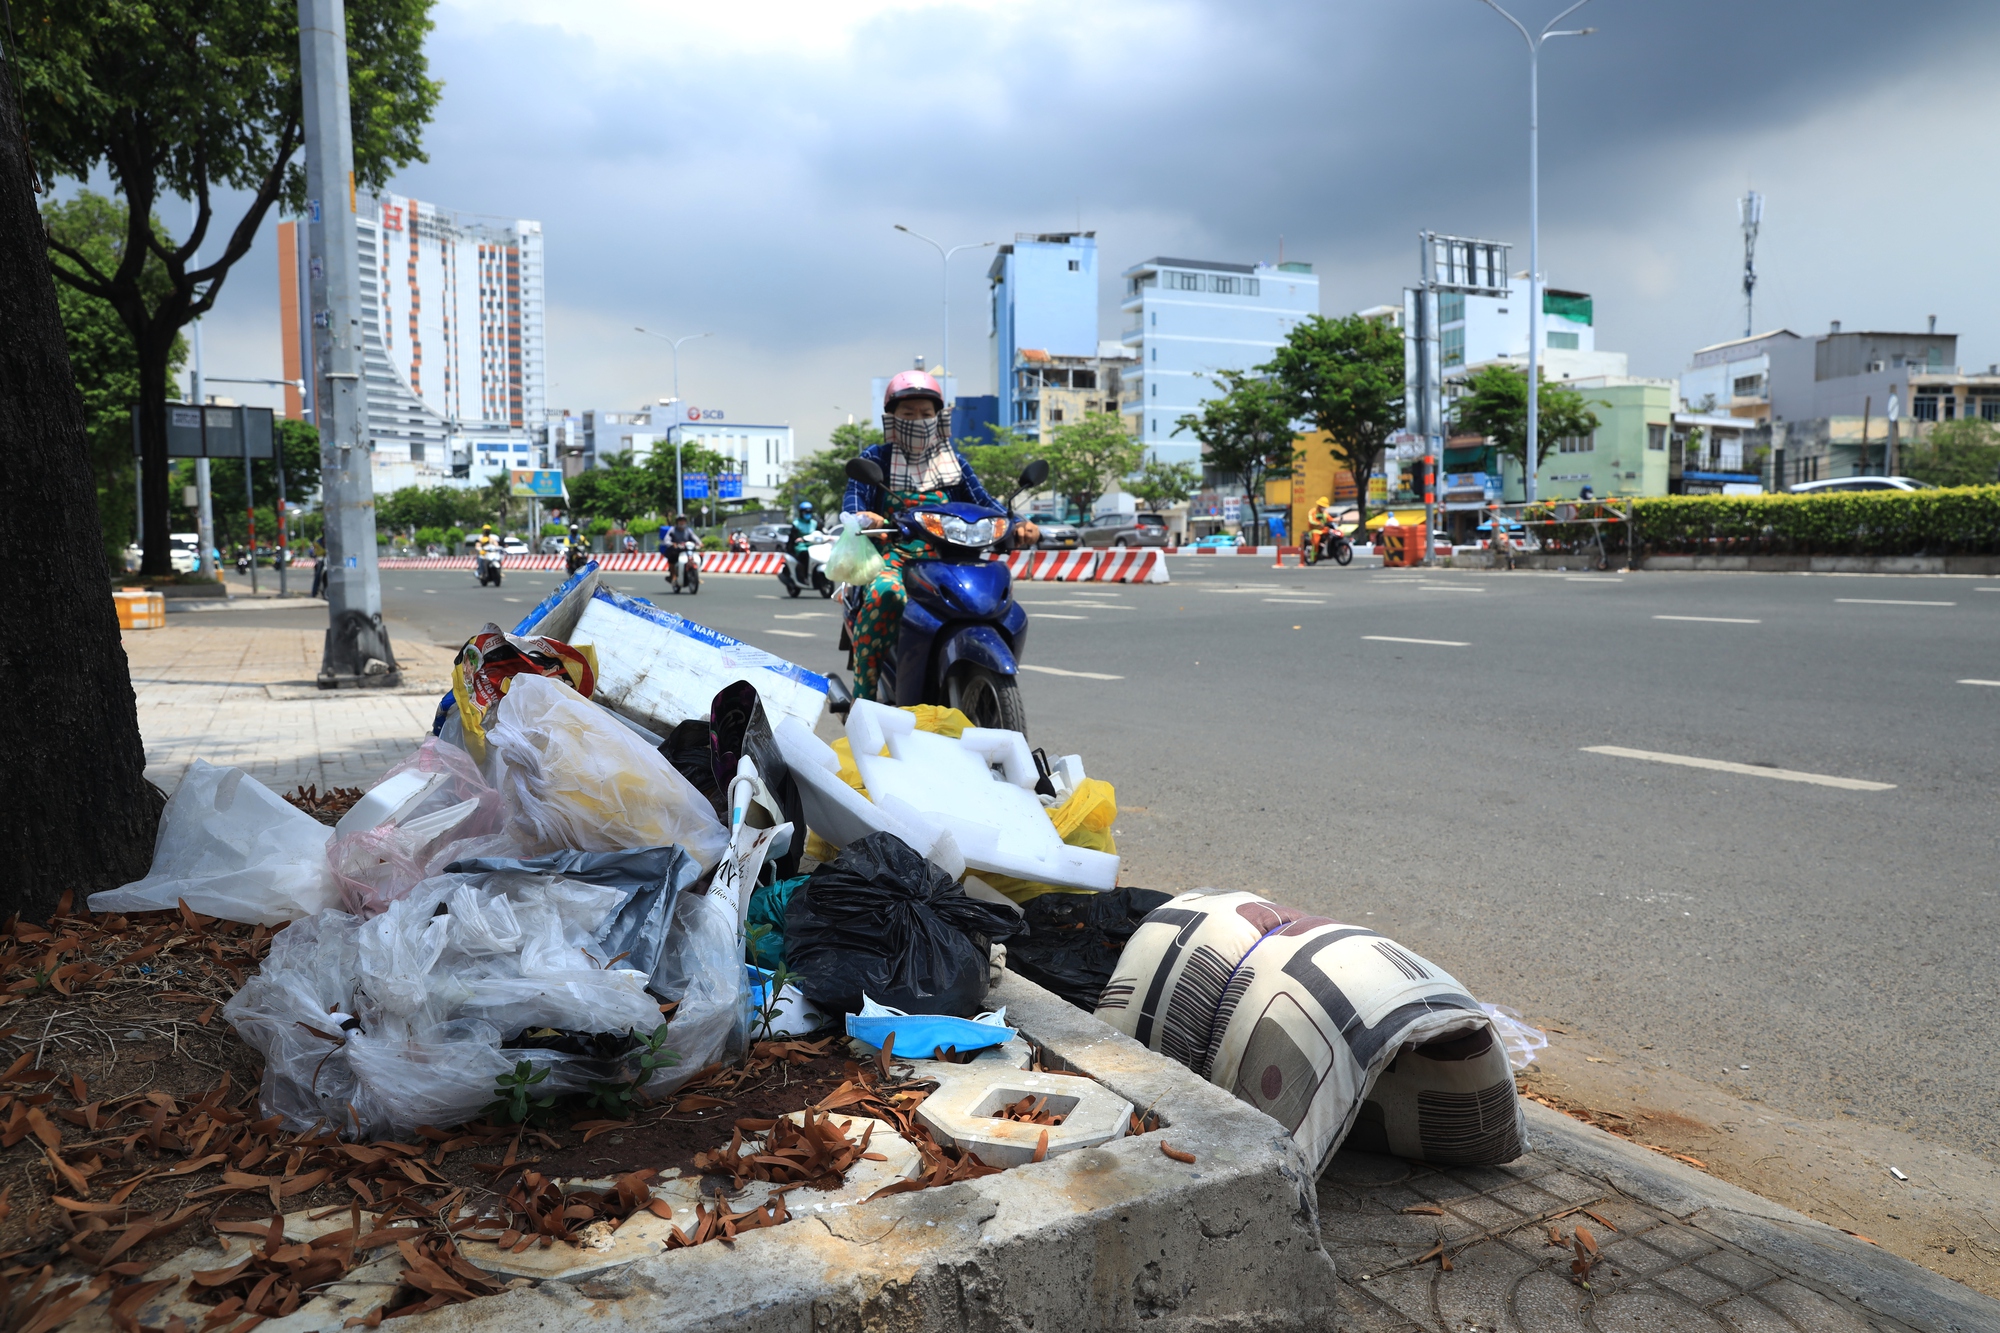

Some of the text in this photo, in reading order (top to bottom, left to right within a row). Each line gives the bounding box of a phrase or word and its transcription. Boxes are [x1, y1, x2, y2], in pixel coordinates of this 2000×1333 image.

[382, 203, 403, 231] H
[702, 410, 725, 419] SCB
[634, 605, 736, 646] MUSHROOM NAM KIM
